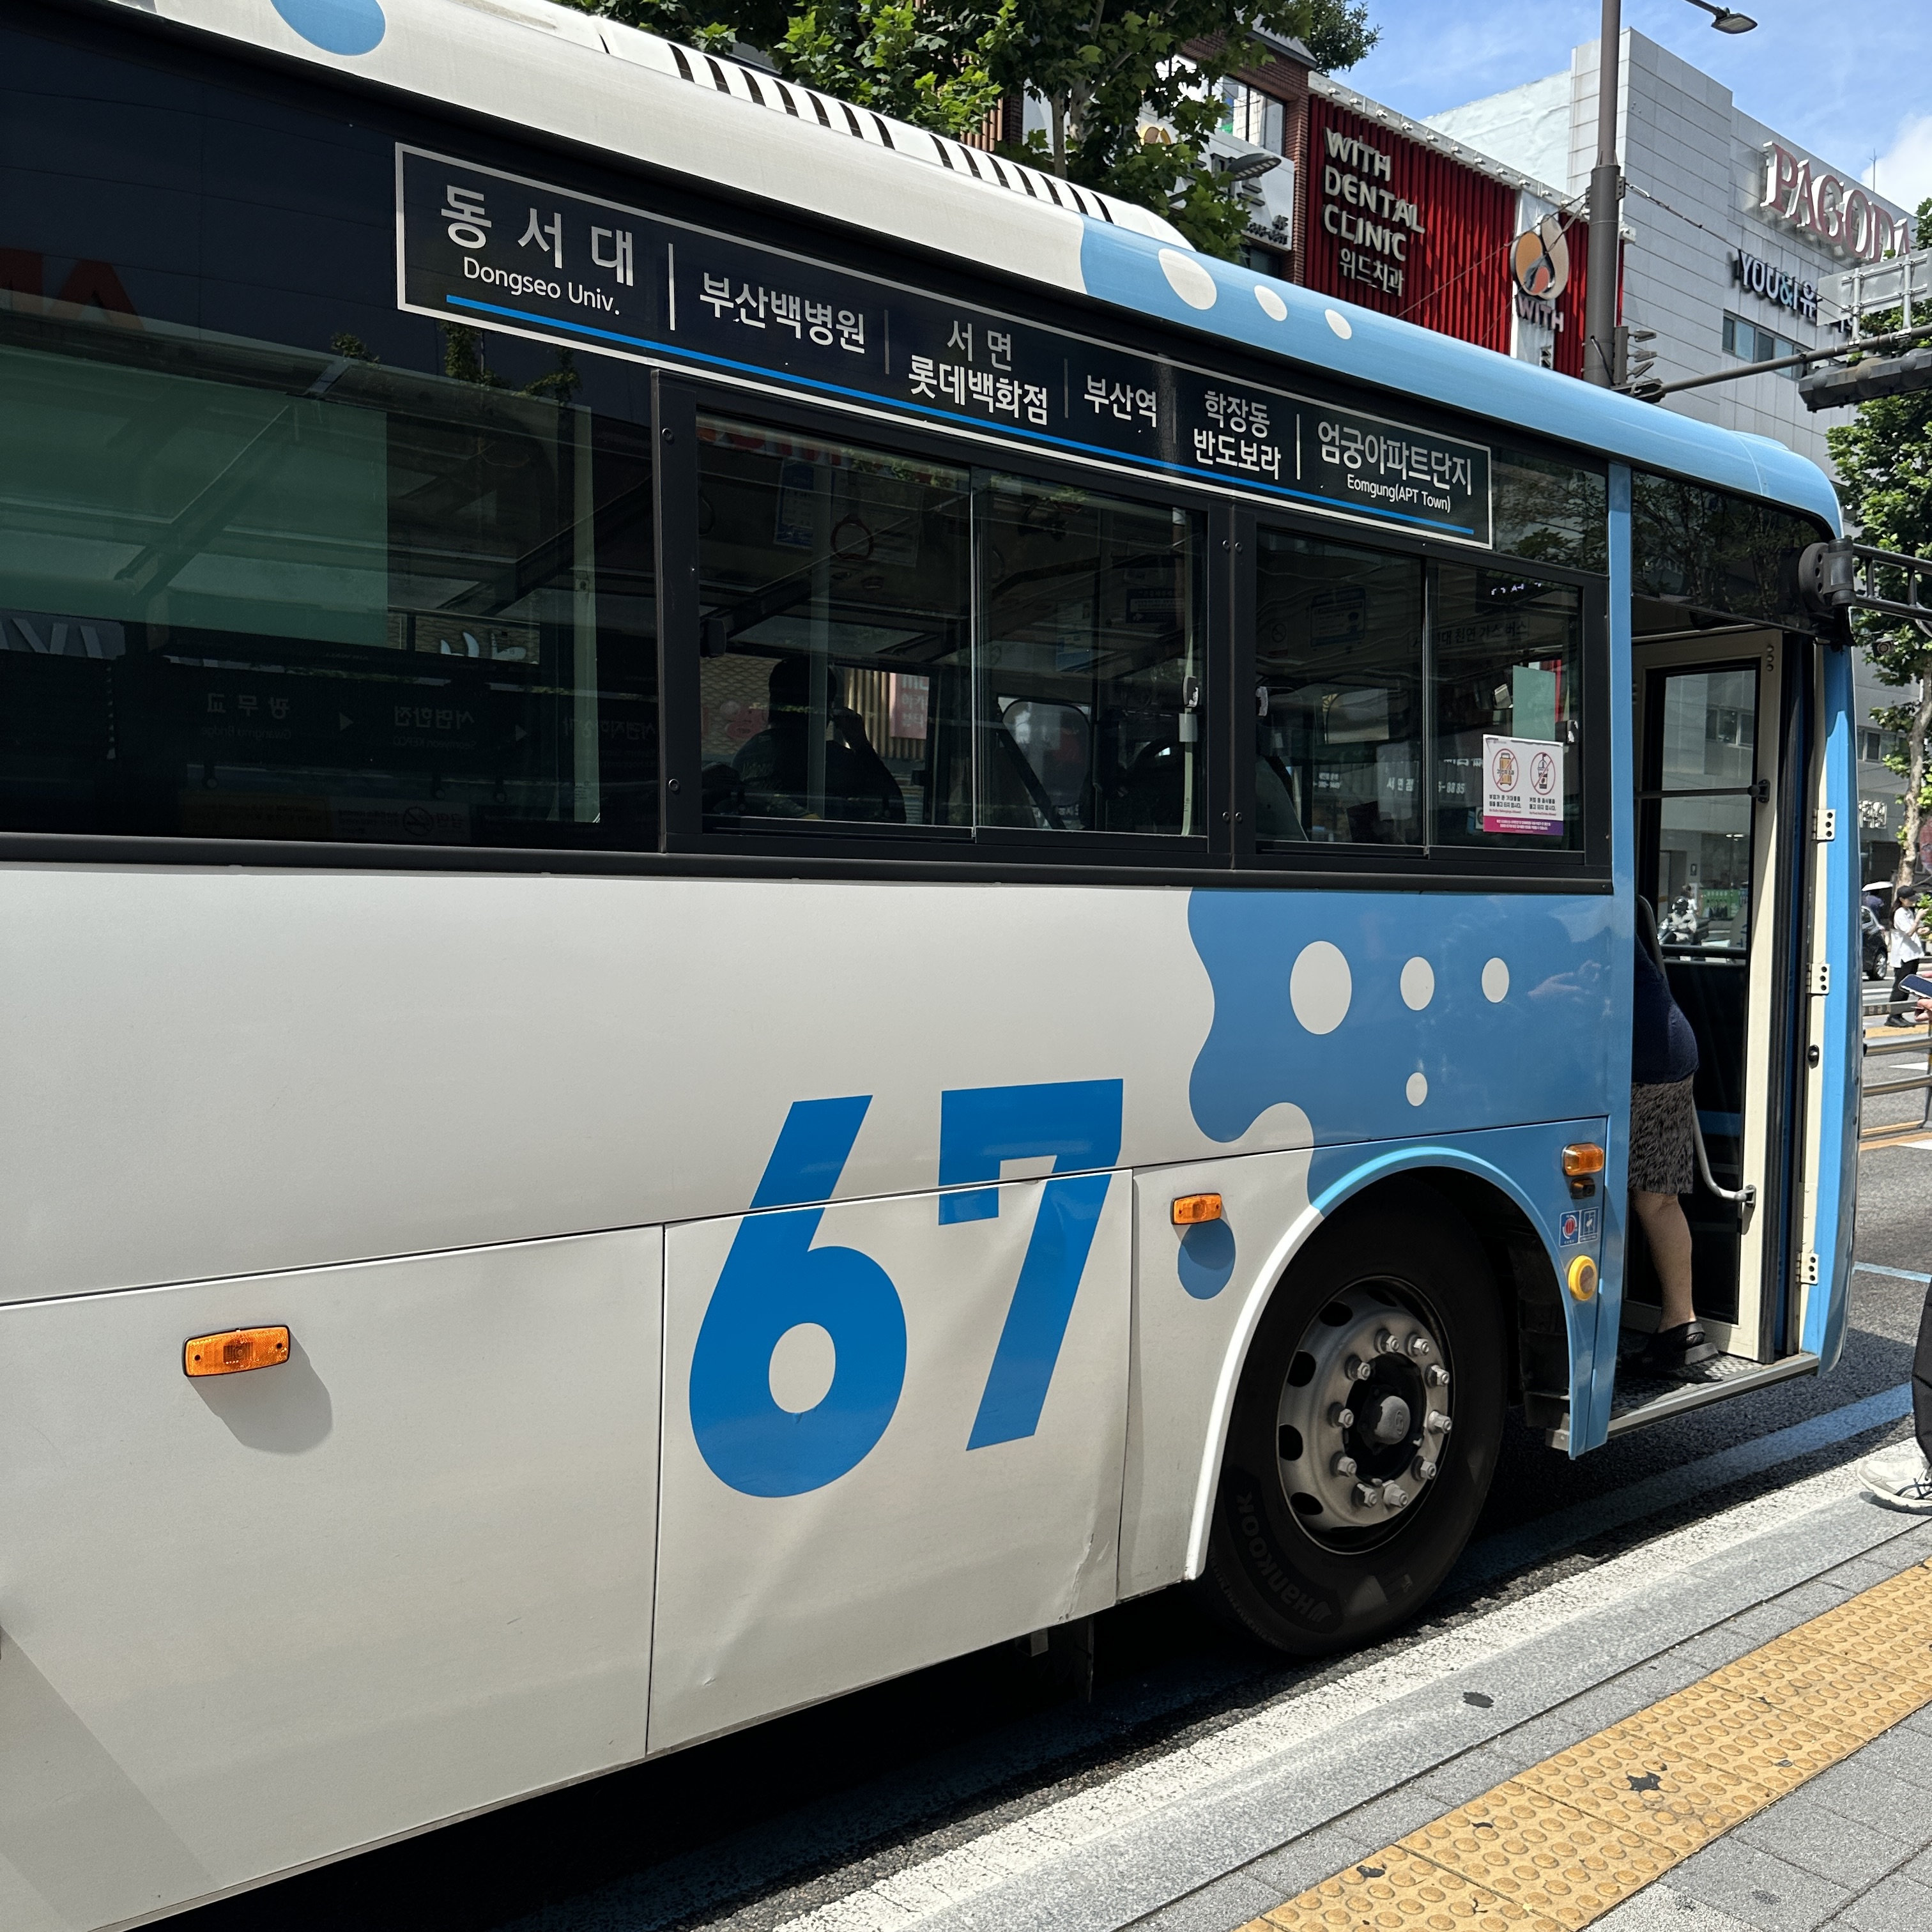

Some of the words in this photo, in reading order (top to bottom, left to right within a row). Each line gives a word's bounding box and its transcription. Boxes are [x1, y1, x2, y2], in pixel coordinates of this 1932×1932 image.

[1324, 127, 1391, 182] WITH
[1324, 164, 1426, 234] DENTAL
[1760, 141, 1910, 263] PAGODA
[1324, 203, 1406, 262] CLINIC
[464, 256, 561, 299] Dongseo
[568, 282, 620, 316] Univ.
[1340, 248, 1404, 297] 위드치과
[700, 272, 866, 355] 부산백병원
[1517, 294, 1564, 333] WITH
[908, 355, 1048, 426] 롯데백화점
[1084, 375, 1157, 429] 부산역
[1204, 390, 1271, 439] 학장동
[1193, 428, 1282, 480] 반도보라
[1317, 422, 1472, 496] 엄궁아파트단지
[1347, 473, 1419, 503] Eomgung(APT
[1421, 491, 1451, 514] Town)
[689, 1078, 1124, 1498] 67
